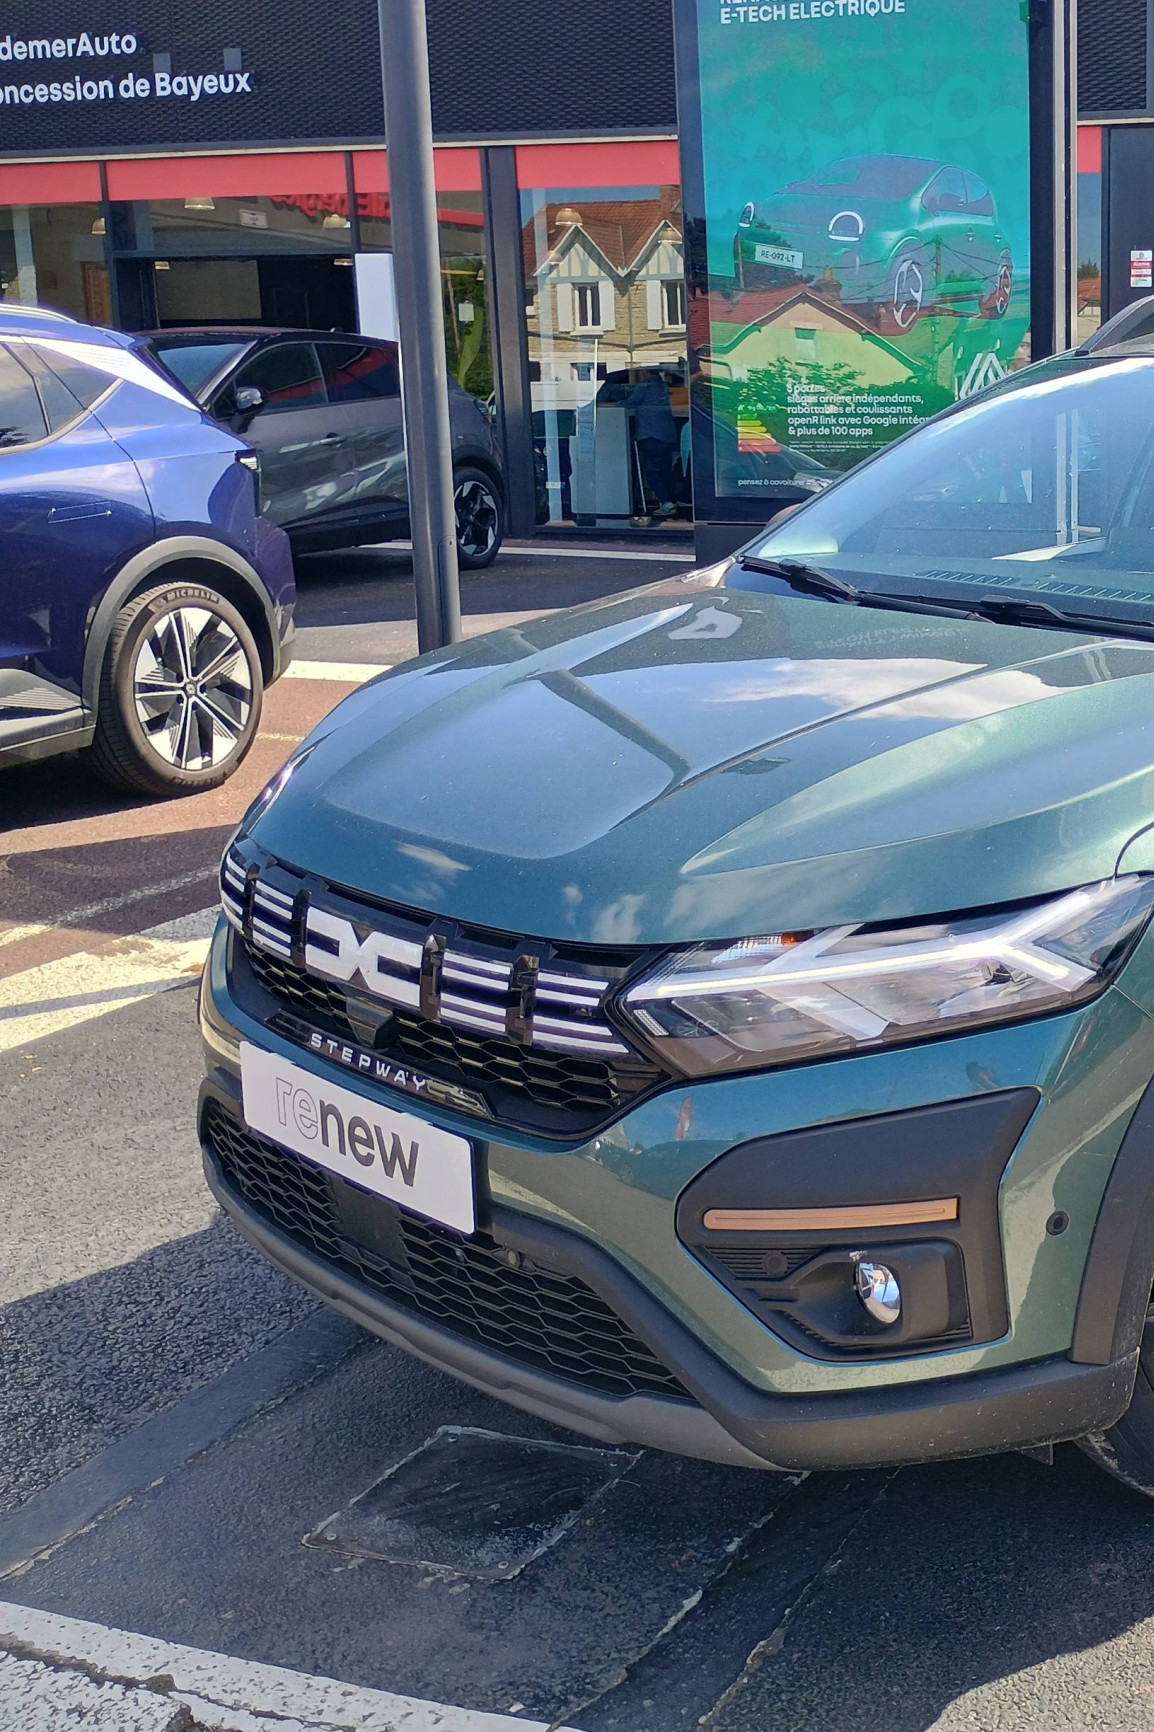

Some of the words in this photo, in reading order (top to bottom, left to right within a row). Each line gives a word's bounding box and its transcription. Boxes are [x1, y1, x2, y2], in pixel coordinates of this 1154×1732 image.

[720, 5, 786, 24] E-TECH
[789, 0, 905, 20] ELECTRIQUE
[0, 32, 137, 60] demerAuto
[0, 75, 114, 104] ncession
[118, 73, 150, 98] de
[155, 72, 252, 101] Bayeux
[852, 393, 924, 405] indépendants,
[787, 404, 844, 414] rabattables
[845, 405, 855, 414] et
[856, 404, 913, 414] coulissants
[787, 415, 818, 427] openR
[820, 414, 837, 425] link
[838, 417, 862, 425] avec
[863, 415, 898, 427] Google
[788, 426, 796, 435] &
[797, 425, 816, 437] plus
[818, 426, 830, 435] de
[831, 426, 848, 435] 100
[849, 427, 873, 437] apps
[737, 479, 763, 487] pensez
[310, 1032, 426, 1092] STEPWAY
[275, 1077, 420, 1188] renew
